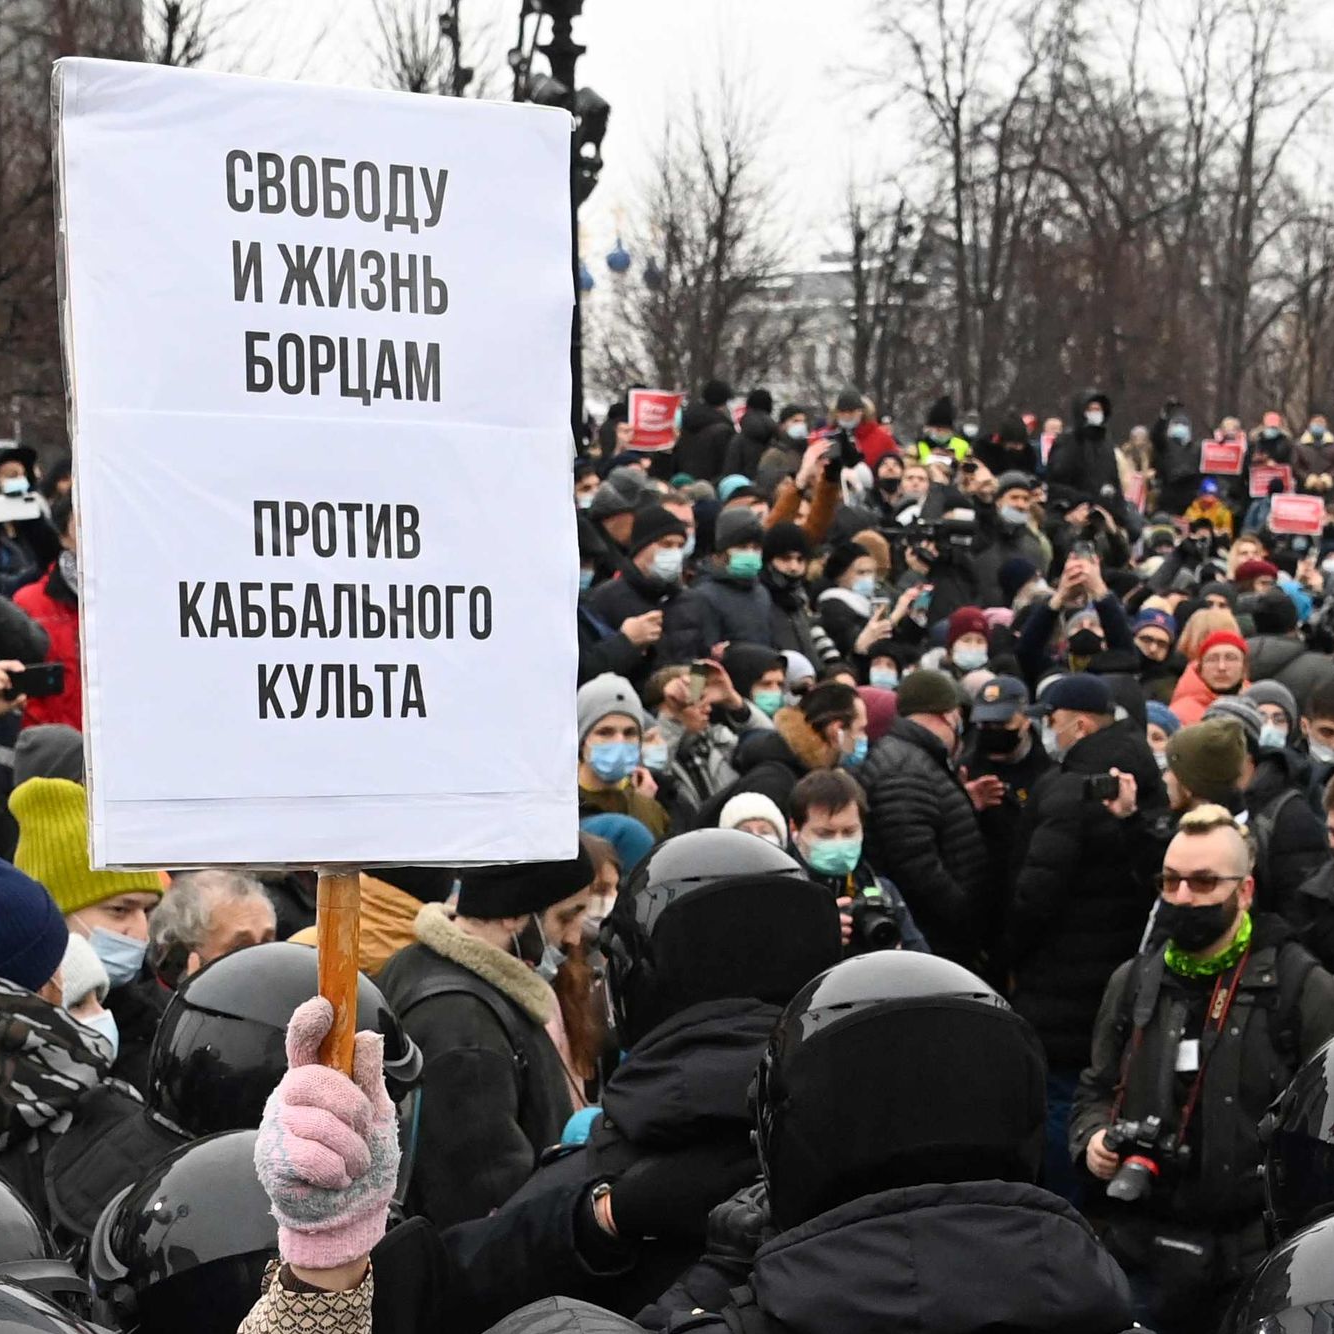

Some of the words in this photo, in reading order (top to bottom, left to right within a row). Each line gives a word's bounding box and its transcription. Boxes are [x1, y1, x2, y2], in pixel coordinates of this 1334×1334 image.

[225, 149, 449, 233] СВОБОДУ
[231, 240, 265, 303] И
[276, 243, 449, 316] ЖИЗНЬ
[244, 330, 441, 406] БОРЦАМ
[252, 500, 422, 559] ПРОТИВ
[178, 581, 493, 640] КАББАЛЬНОГО
[256, 663, 427, 719] КУЛЬТА
